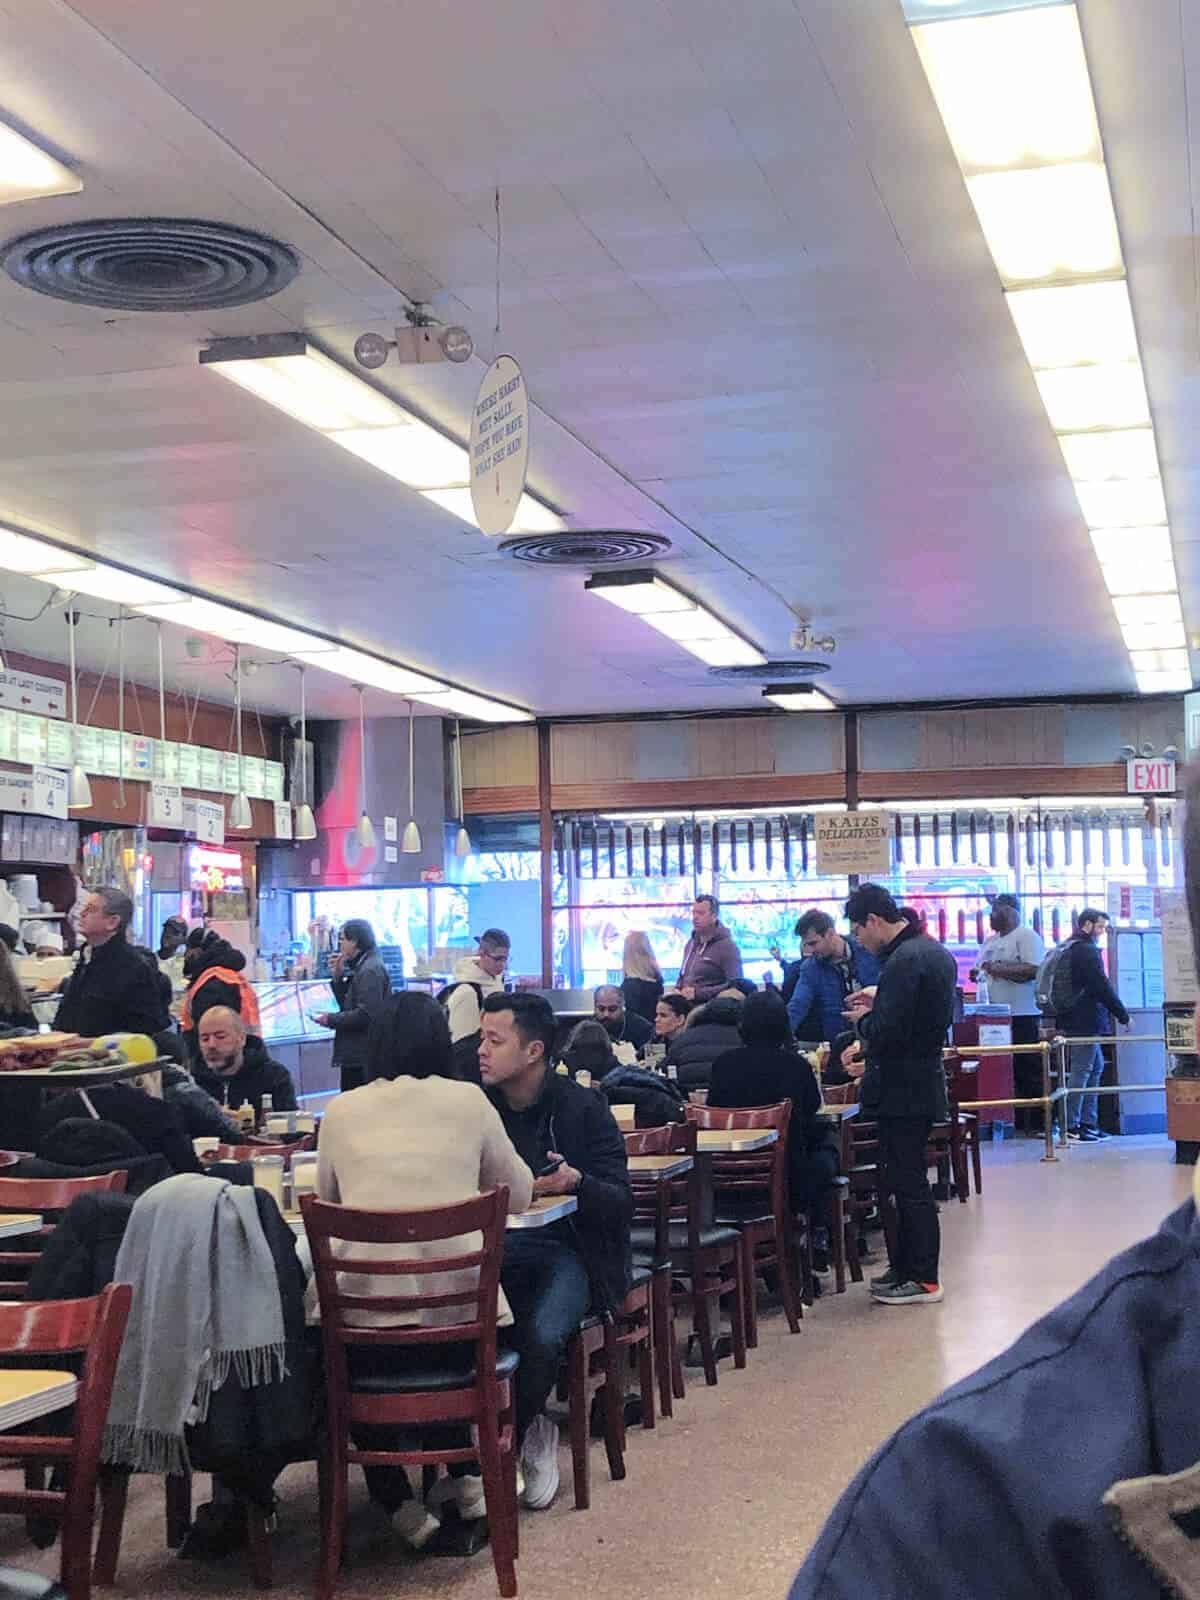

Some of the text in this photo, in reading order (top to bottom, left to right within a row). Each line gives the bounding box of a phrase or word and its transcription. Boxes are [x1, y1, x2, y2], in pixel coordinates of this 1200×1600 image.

[493, 400, 512, 425] SALLY
[35, 770, 65, 790] CUTTER
[1135, 763, 1168, 790] EXIT
[47, 789, 55, 809] 4
[154, 784, 179, 798] CUTTER
[164, 799, 171, 817] 3
[199, 804, 223, 820] CUTTER
[208, 819, 214, 838] 2
